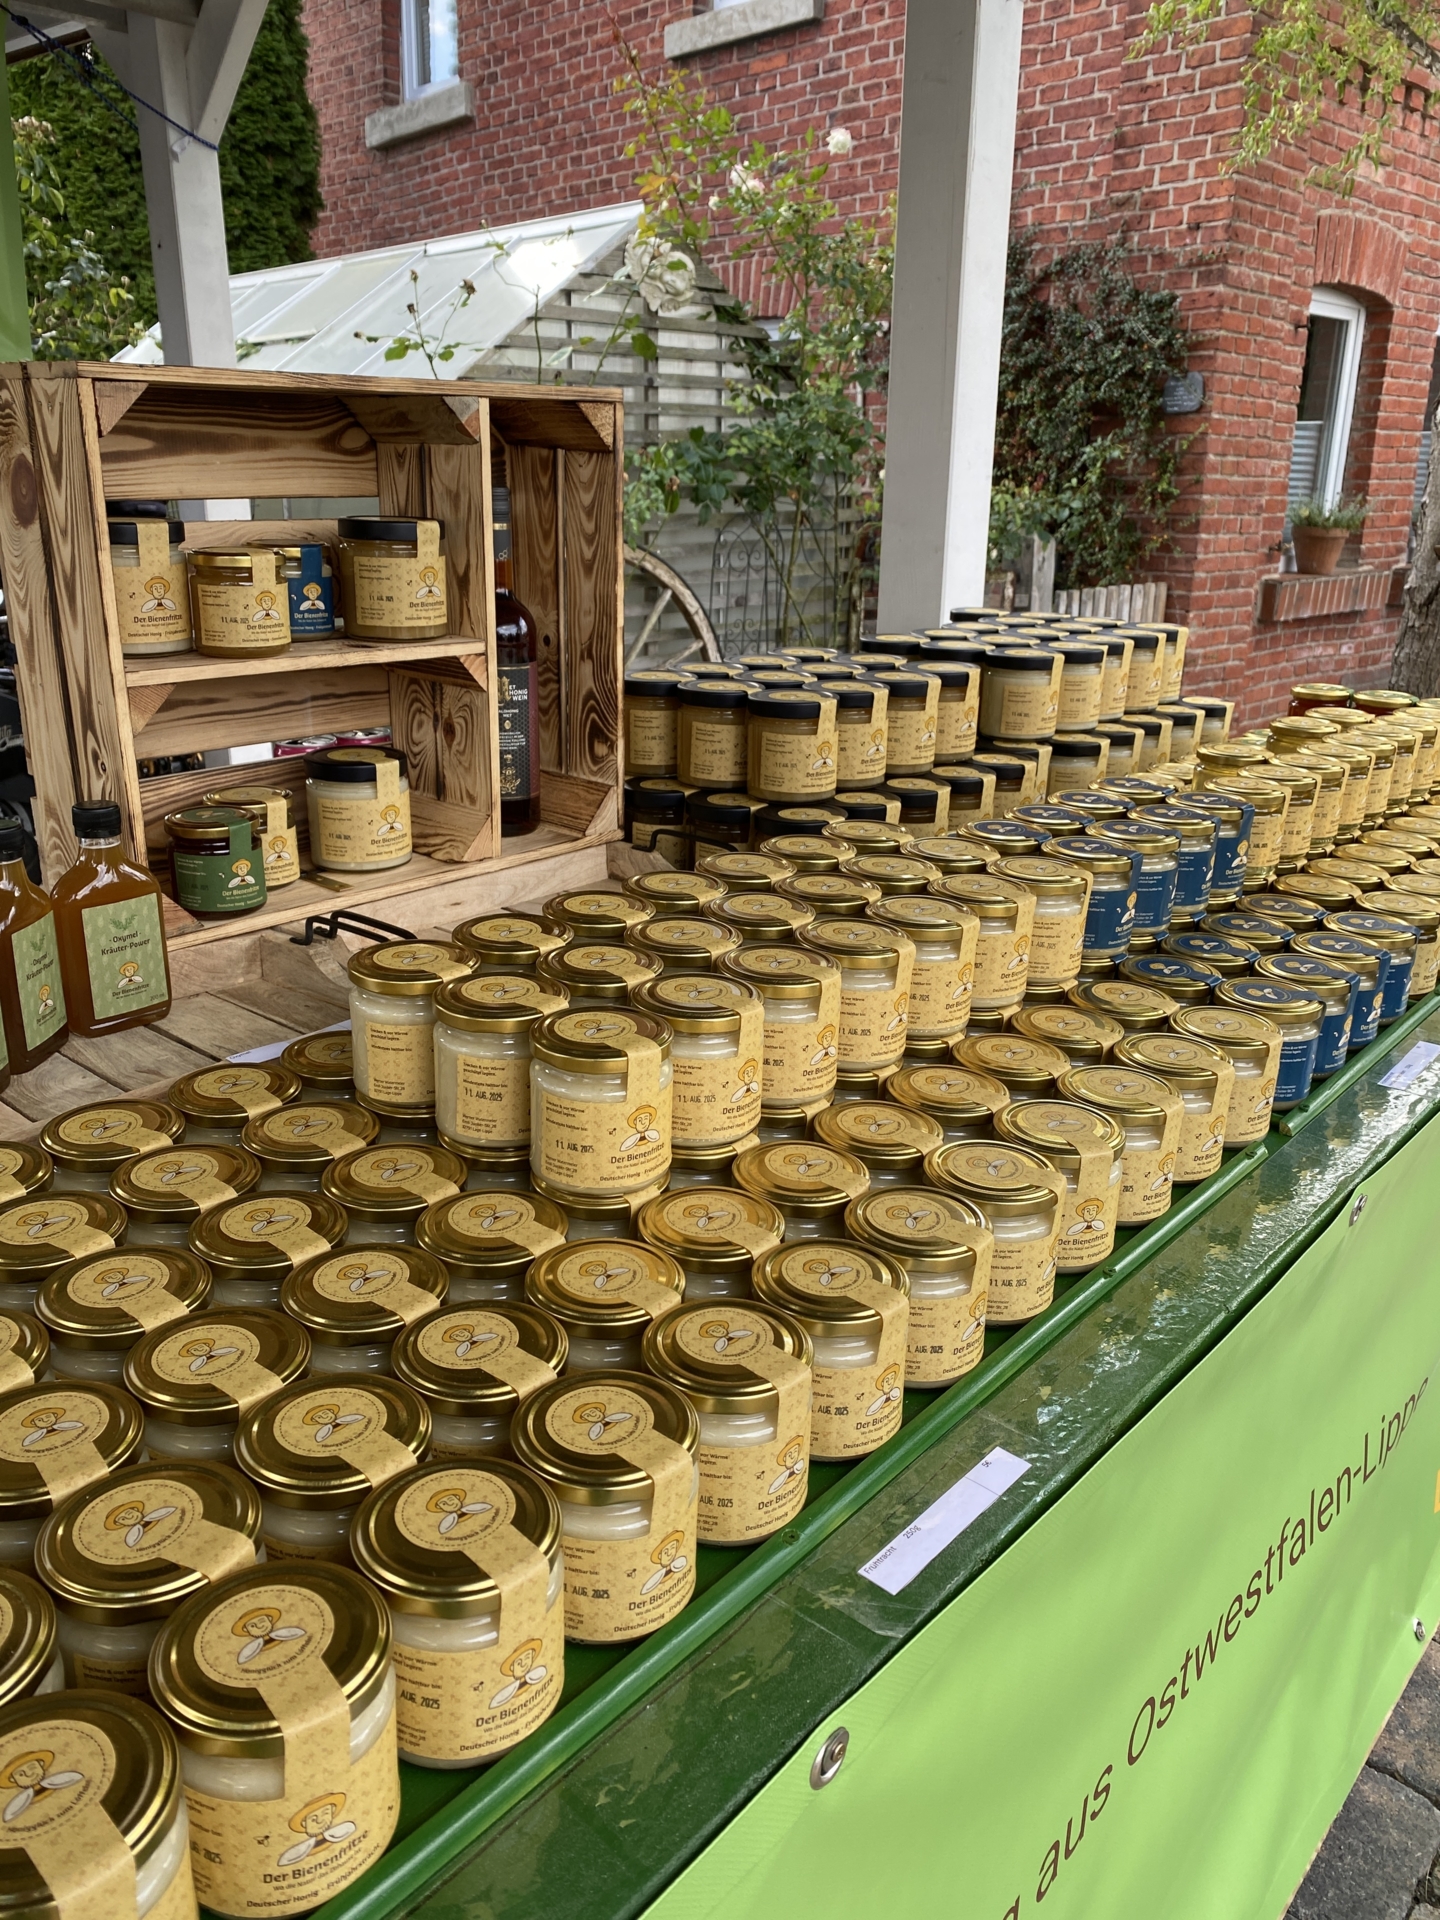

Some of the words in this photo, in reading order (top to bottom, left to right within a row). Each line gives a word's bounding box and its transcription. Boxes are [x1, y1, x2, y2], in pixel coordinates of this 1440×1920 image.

[134, 616, 147, 624] Der
[148, 614, 183, 623] Bienenfritze
[112, 930, 138, 943] Oxymel
[101, 938, 151, 956] Kräuter-Power
[918, 994, 930, 1002] 2025
[945, 1002, 955, 1010] Der
[847, 1027, 859, 1036] AUG.
[860, 1028, 872, 1036] 2025
[879, 1034, 890, 1042] Der
[772, 1059, 785, 1067] 2025
[802, 1068, 814, 1077] Der
[475, 1091, 488, 1100] AUG.
[489, 1091, 503, 1102] 2025
[689, 1095, 701, 1104] AUG.
[704, 1094, 717, 1104] 2025
[722, 1106, 734, 1115] Der
[566, 1142, 578, 1152] AUG.
[580, 1144, 595, 1154] 2025
[610, 1155, 625, 1164] Der
[626, 1142, 665, 1162] Bienenfritze
[600, 1173, 626, 1182] Deutscher
[626, 1171, 641, 1179] Honig
[1122, 1185, 1134, 1193] 2025
[1142, 1192, 1153, 1202] Der
[1057, 1238, 1071, 1246] Der
[1072, 1232, 1109, 1246] Bienenfritze
[1001, 1279, 1014, 1287] AUG.
[1015, 1278, 1028, 1288] 2025
[1036, 1285, 1044, 1294] Der
[914, 1345, 928, 1354] AUG.
[930, 1345, 944, 1354] 2025
[953, 1346, 965, 1356] Der
[942, 1363, 965, 1374] Deutscher
[815, 1372, 833, 1380] Wärme
[817, 1404, 832, 1416] AUG.
[834, 1406, 849, 1416] 2025
[855, 1421, 870, 1431] Der
[842, 1440, 870, 1450] Deutscher
[870, 1435, 884, 1444] Honig
[981, 1459, 993, 1469] 5€
[703, 1472, 722, 1480] haltbar
[699, 1494, 715, 1506] AUG.
[717, 1497, 734, 1508] 2025
[757, 1500, 774, 1511] Der
[745, 1518, 774, 1532] Deutscher
[774, 1511, 789, 1523] Honig
[575, 1547, 595, 1555] Wärme
[863, 1545, 898, 1575] Frühtracht
[902, 1524, 923, 1540] 250g
[563, 1551, 583, 1560] lagern.
[568, 1567, 589, 1575] haltbar
[572, 1585, 590, 1598] AUG.
[591, 1588, 610, 1600] 2025
[628, 1599, 647, 1612] Der
[649, 1565, 693, 1606] Bienenfritze
[613, 1621, 647, 1633] Deutscher
[648, 1612, 665, 1624] Honig
[1034, 1762, 1114, 1904] aus
[1126, 1376, 1430, 1767] Ostwestfalen-Lippe
[403, 1660, 425, 1673] lagern.
[415, 1657, 438, 1667] Wärme
[240, 1663, 282, 1675] Honigglück
[408, 1678, 430, 1688] haltbar
[400, 1688, 418, 1705] AUG.
[420, 1696, 440, 1710] 2025
[475, 1714, 497, 1728] Der
[499, 1674, 554, 1721] Bienenfritze
[483, 1726, 494, 1734] Wo
[493, 1723, 503, 1731] die
[503, 1717, 518, 1727] Natur
[459, 1738, 499, 1752] Deutscher
[499, 1728, 520, 1742] Honig
[7, 1817, 55, 1833] Honigglück
[56, 1804, 74, 1818] zum
[203, 1847, 223, 1865] 2025
[262, 1872, 289, 1885] Der
[291, 1829, 370, 1881] Bienenfritze
[246, 1898, 292, 1909] Deutscher
[292, 1889, 320, 1904] Honig
[325, 1842, 381, 1891] Frühjahrstracht
[273, 1884, 285, 1892] Wo
[285, 1882, 296, 1890] die
[297, 1877, 316, 1888] Natur
[317, 1871, 329, 1881] das
